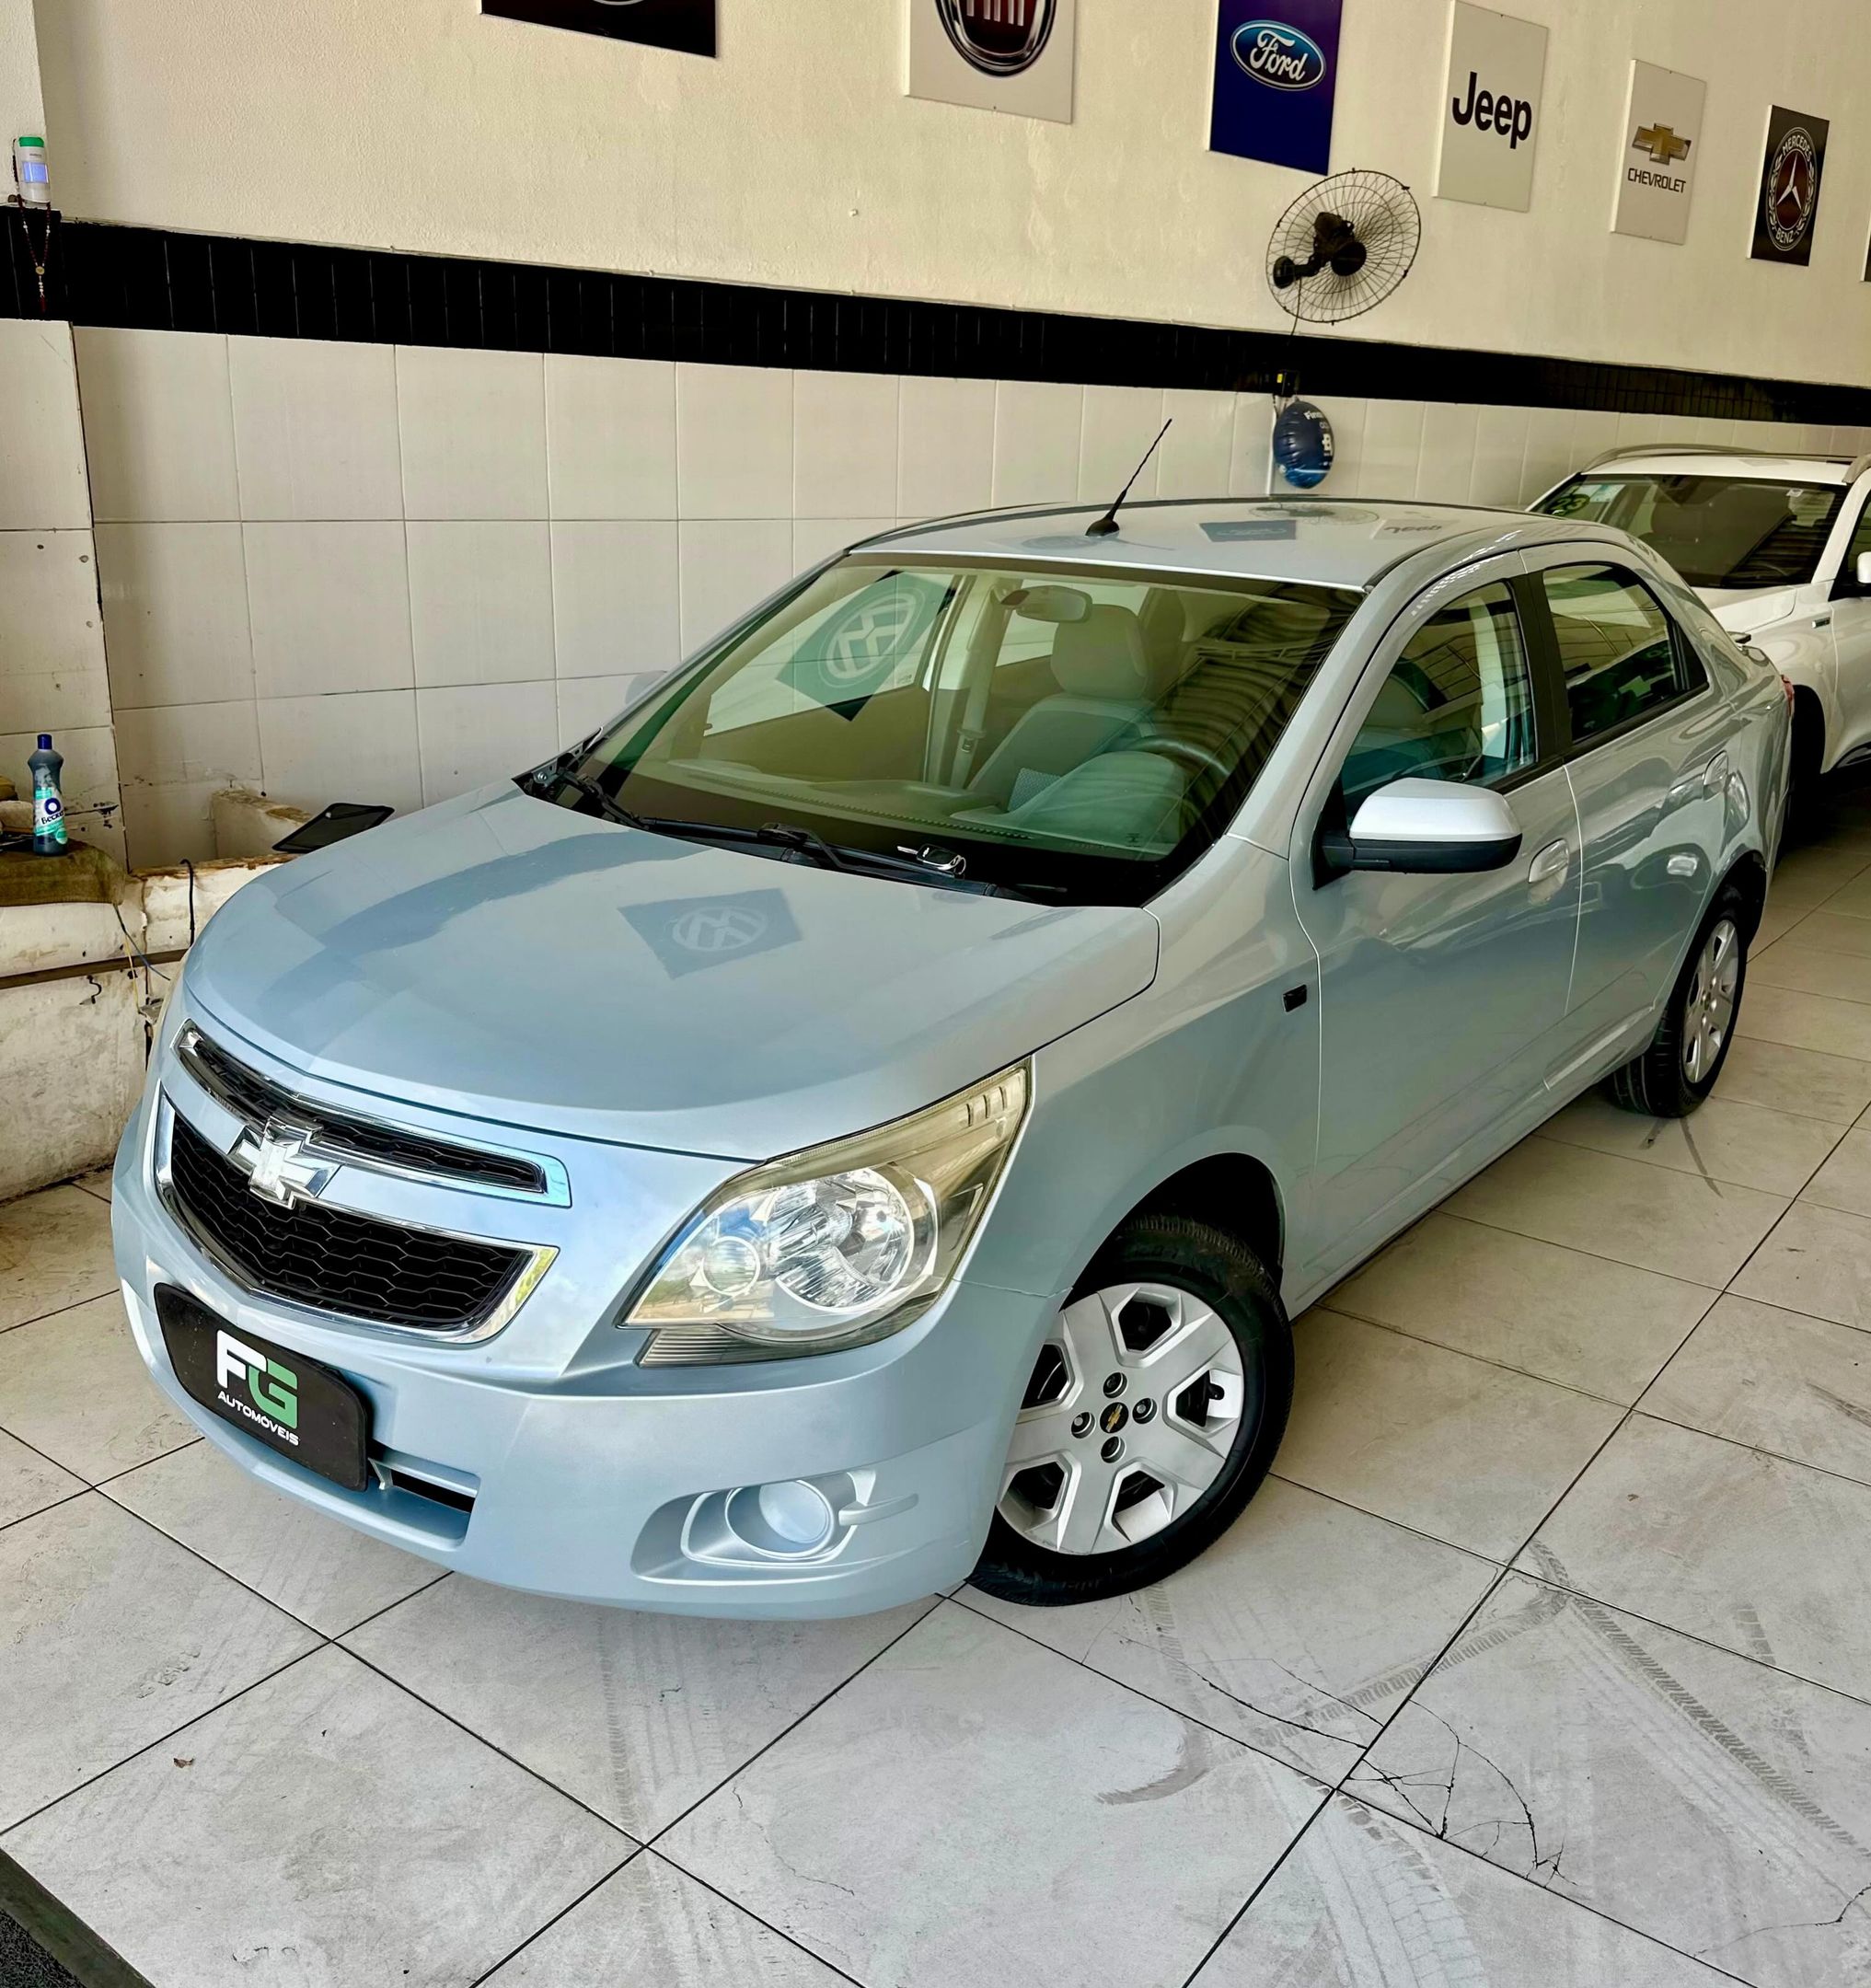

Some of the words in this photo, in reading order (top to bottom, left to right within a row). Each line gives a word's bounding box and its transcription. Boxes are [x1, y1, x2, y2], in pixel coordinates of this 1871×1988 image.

[1250, 29, 1309, 81] Ford
[1451, 71, 1532, 150] Jeep
[1782, 135, 1813, 162] MERCEDES
[1627, 168, 1687, 193] CHEVROLET
[1775, 229, 1794, 244] BENZ
[216, 1329, 298, 1429] FG
